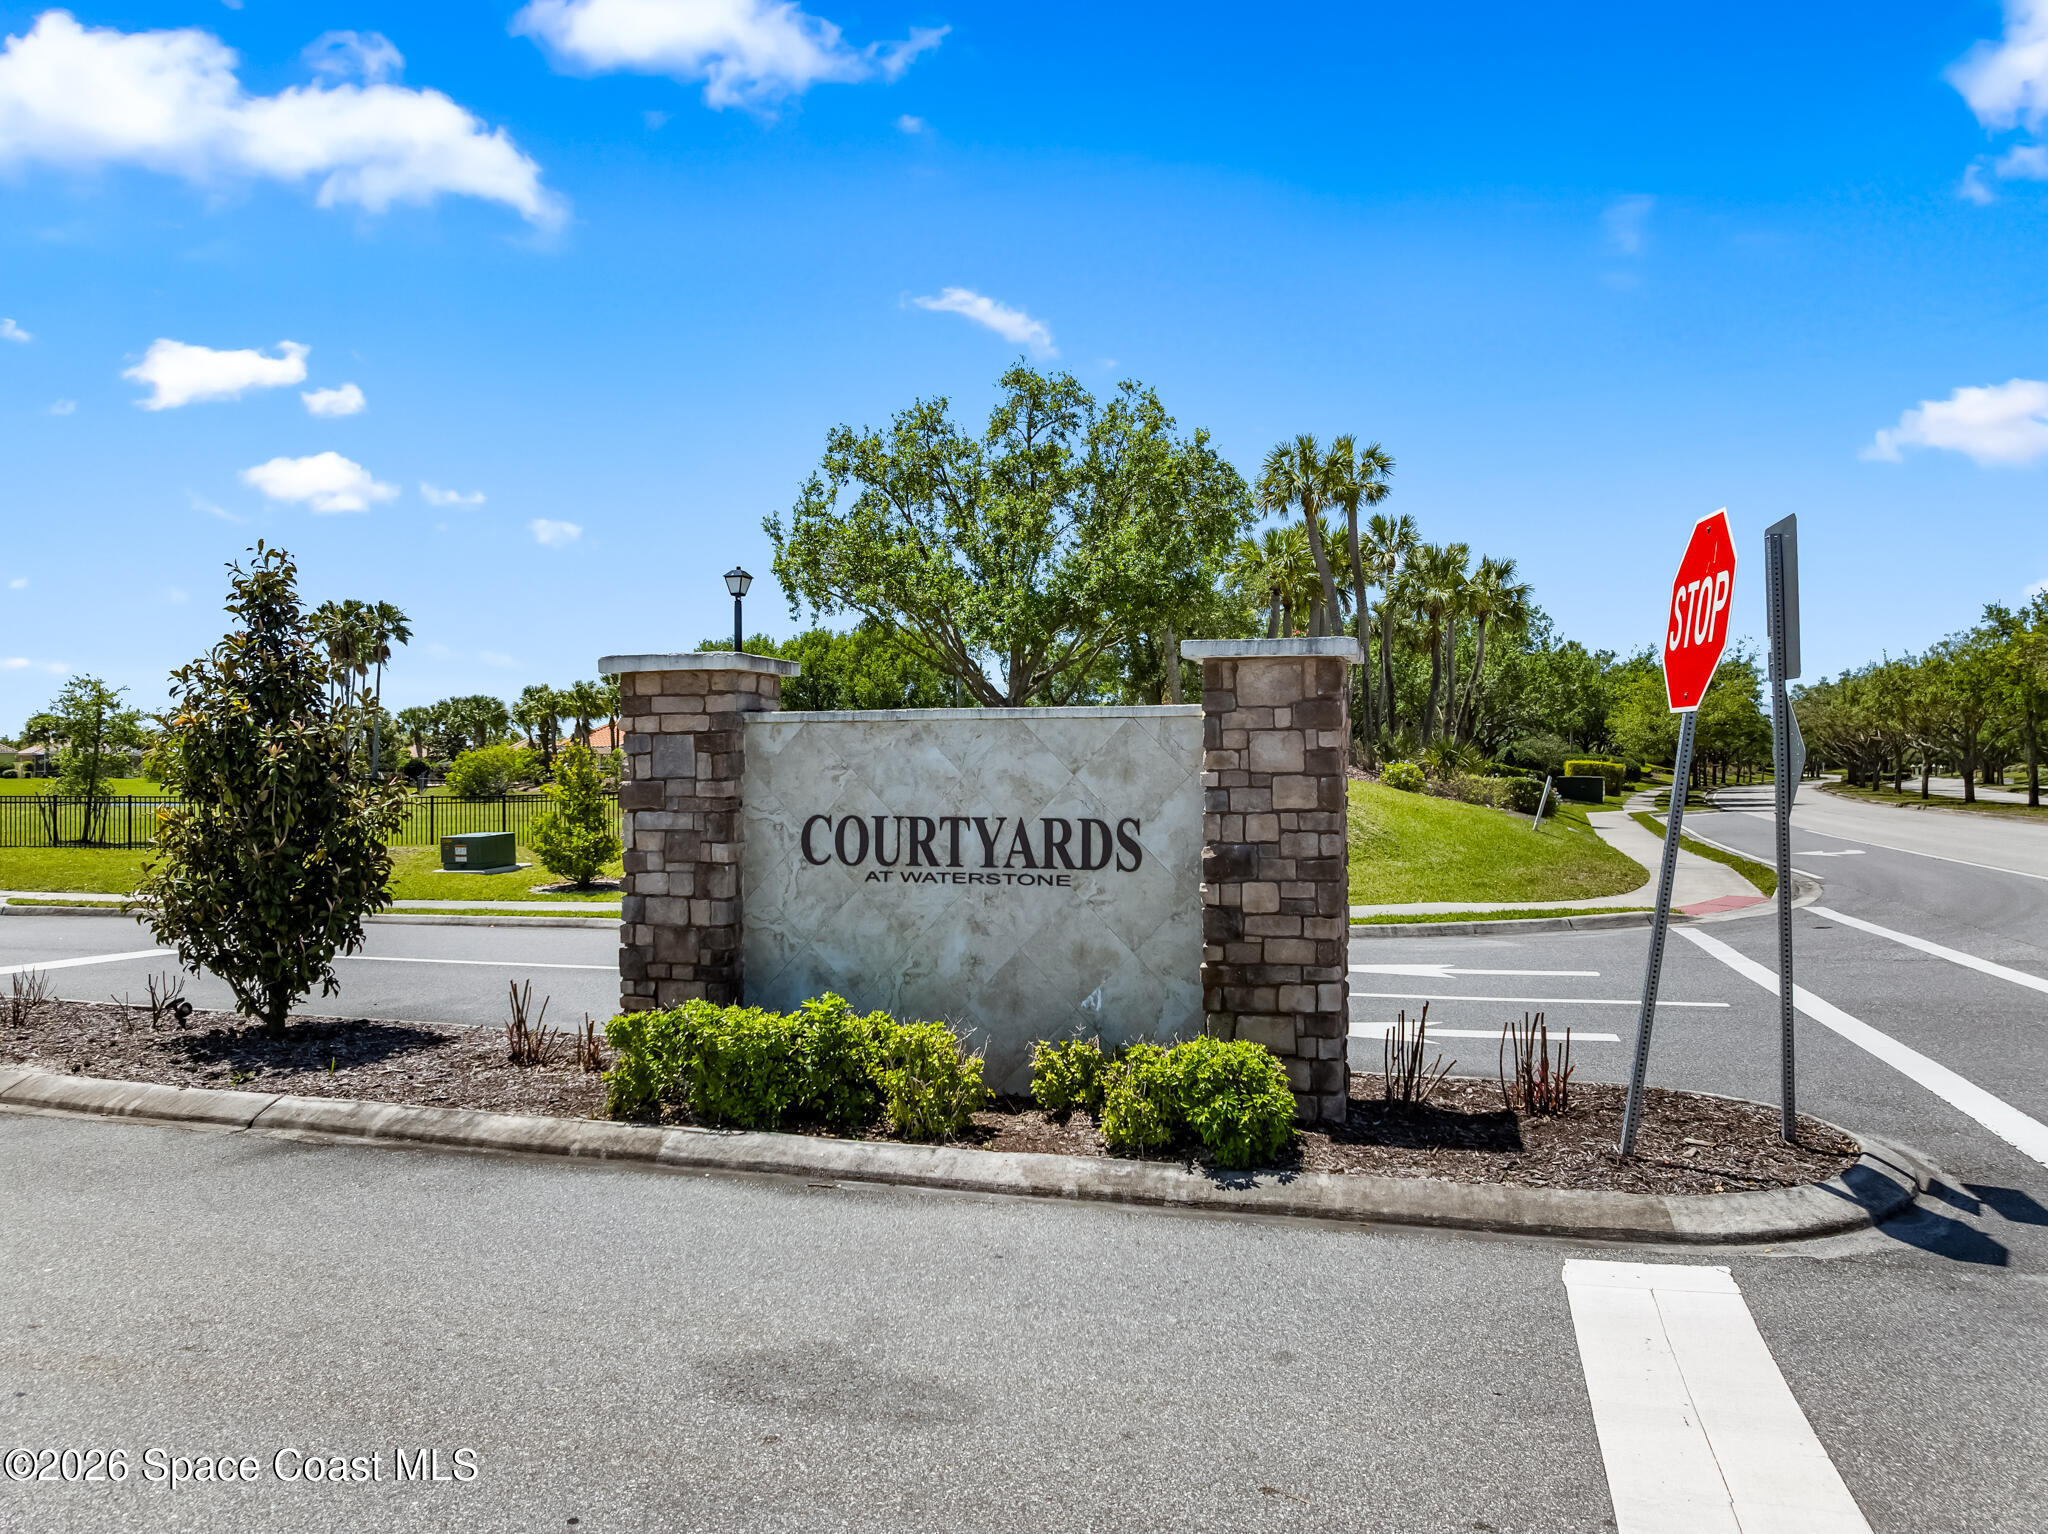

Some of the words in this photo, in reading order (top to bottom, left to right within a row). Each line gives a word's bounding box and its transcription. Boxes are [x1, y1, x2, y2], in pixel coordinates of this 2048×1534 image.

[1669, 570, 1729, 651] STOP
[801, 815, 1143, 873] COURTYARDS
[865, 871, 899, 883] AT
[900, 871, 1071, 887] WATERSTONE
